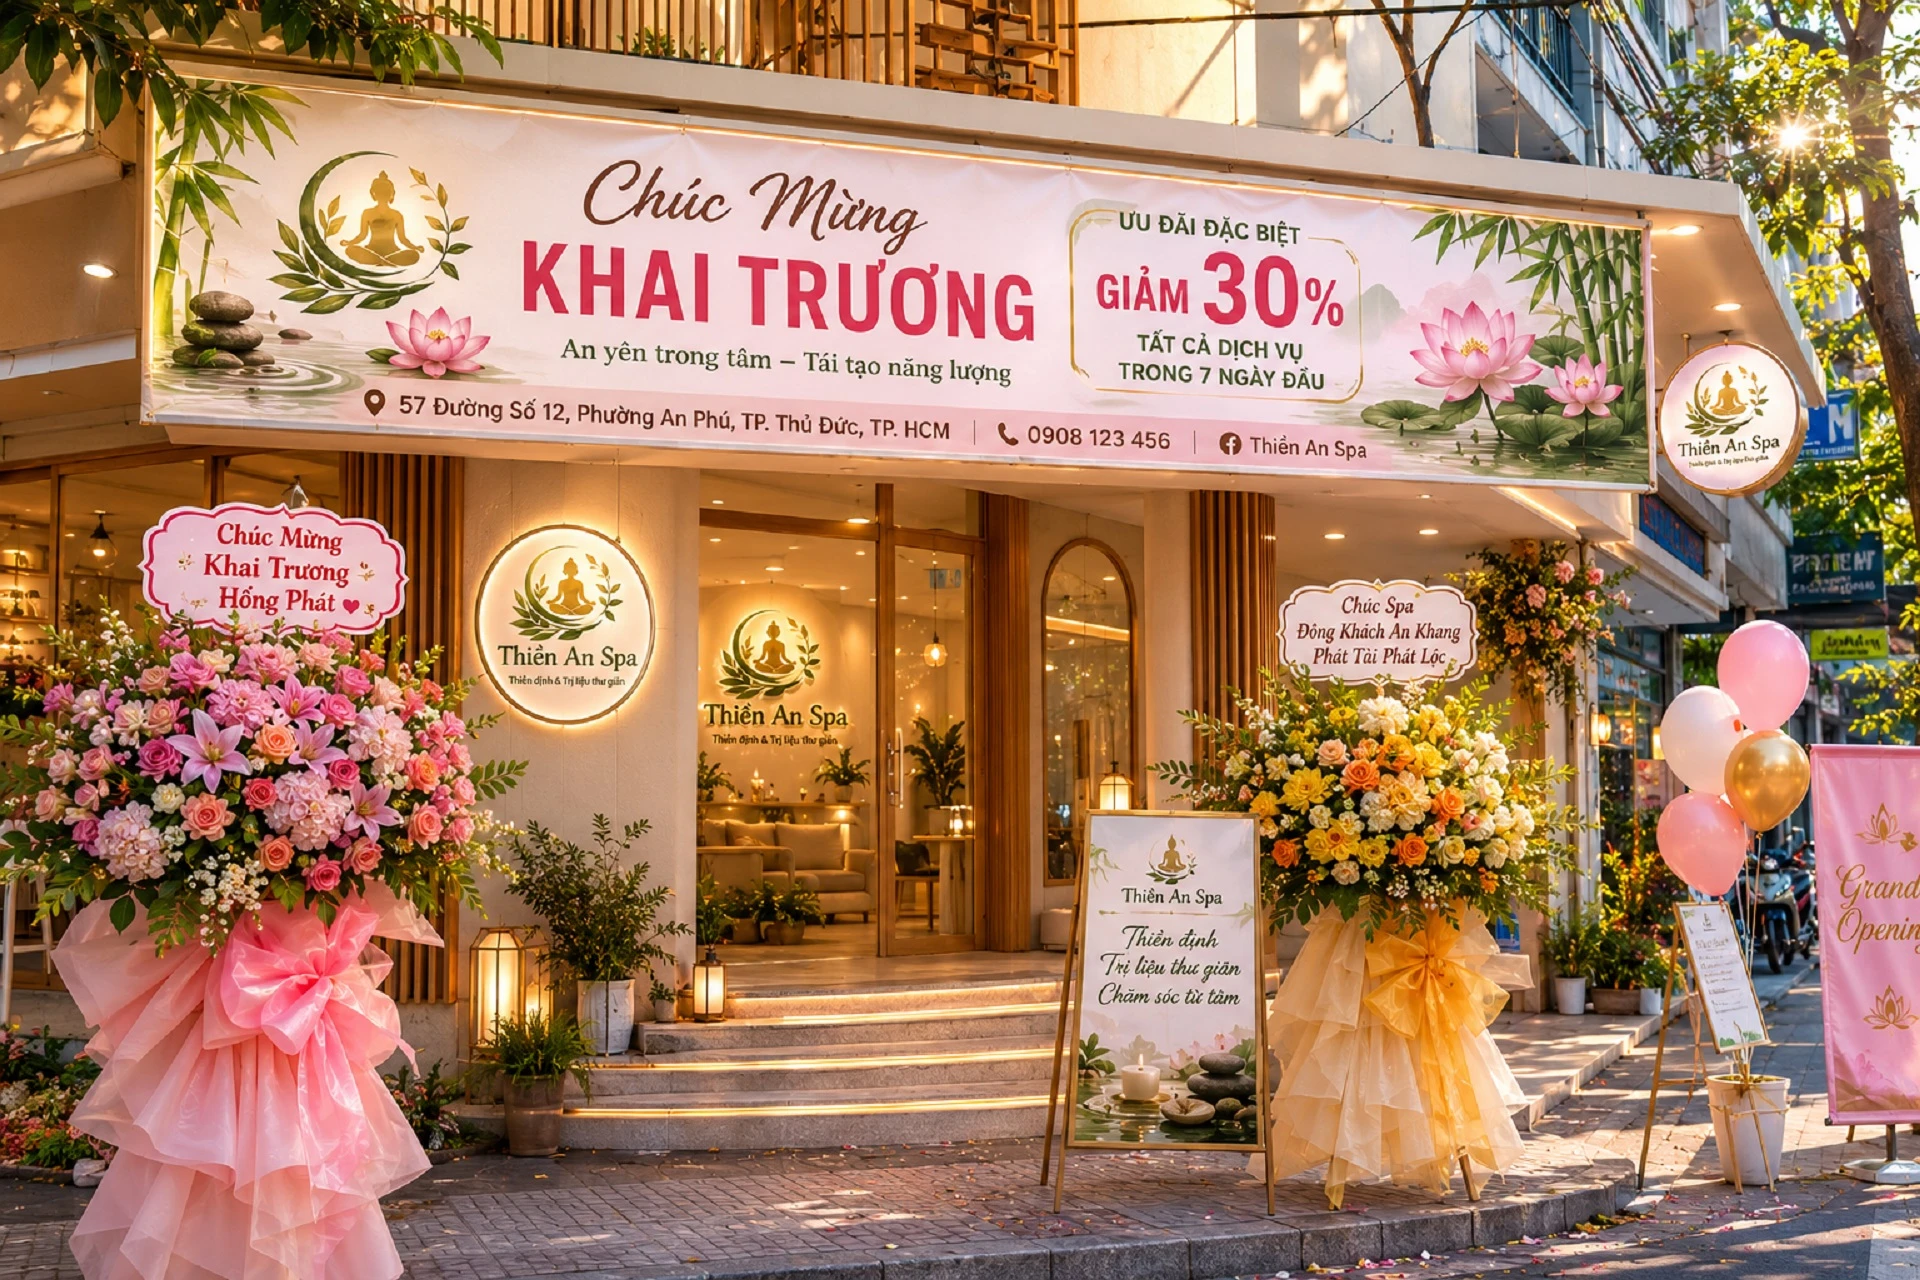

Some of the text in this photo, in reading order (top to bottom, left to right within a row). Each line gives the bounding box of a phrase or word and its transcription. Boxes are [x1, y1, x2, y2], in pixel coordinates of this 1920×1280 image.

[583, 159, 929, 256] Chúc Mừng
[1119, 210, 1301, 248] ƯU ĐÃI ĐẶC BIỆT
[522, 239, 1036, 342] KHAI TRƯƠNG
[1096, 250, 1345, 328] GIẢM 30%
[1137, 329, 1303, 365] TẤT CẢ DỊCH VỤ
[561, 337, 596, 361] An
[603, 339, 647, 367] yên
[655, 344, 719, 371] trong
[726, 347, 772, 371] tâm
[803, 351, 840, 375] Tái
[844, 354, 882, 379] tạo
[887, 356, 943, 384] năng
[949, 358, 1012, 388] lượng
[1118, 362, 1325, 391] TRONG 7 NGÀY ĐẦU
[399, 394, 951, 442] 57 Đường Số 12, Phường An Phú, TP. Thủ Đức, TP. HCM
[1027, 425, 1171, 450] 0908 123 456
[1250, 436, 1367, 460] Thiền An Spa
[1724, 438, 1747, 454] An
[1751, 435, 1780, 453] Spa
[217, 522, 343, 556] Chúc Mừng
[203, 553, 350, 589] Khai Trương
[285, 588, 336, 612] Phát
[1341, 595, 1414, 618] Chúc Spa
[1297, 622, 1461, 644] Đông Khách An Khang
[497, 643, 638, 672] Thiền An Spa
[1313, 647, 1446, 668] Phát Tài Phát Lộc
[703, 702, 849, 733] Thiền An Spa
[1121, 887, 1223, 909] Thiền An Spa
[1835, 863, 1920, 909] Grand
[1121, 925, 1219, 951] Thiền định
[1836, 907, 1920, 955] Openin
[1100, 952, 1131, 978] Trị
[1134, 955, 1166, 978] liệu
[1170, 956, 1200, 976] thư
[1098, 982, 1150, 1005] Chăm
[1154, 987, 1180, 1005] sóc
[1184, 988, 1204, 1004] từ
